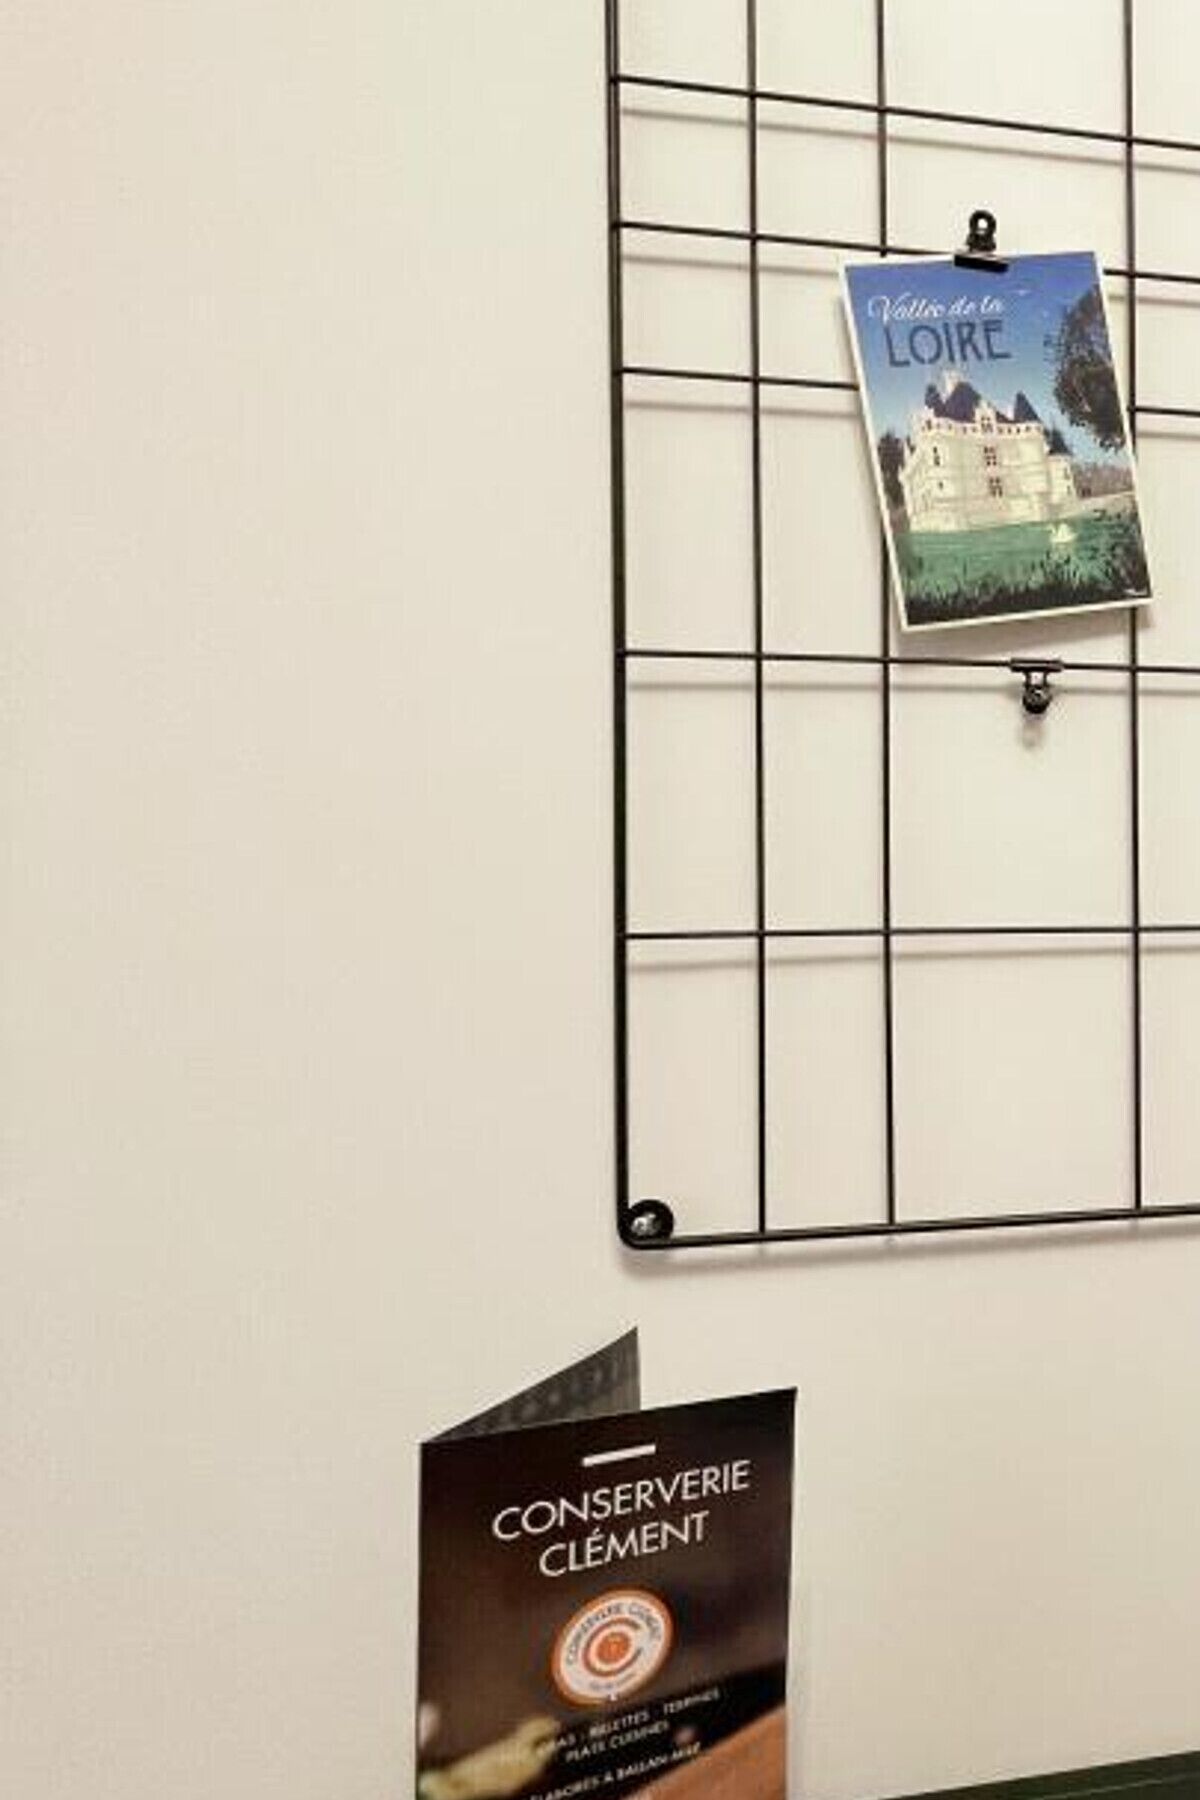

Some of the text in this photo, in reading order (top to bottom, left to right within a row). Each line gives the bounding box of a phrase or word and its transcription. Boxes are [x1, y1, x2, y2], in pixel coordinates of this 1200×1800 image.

[980, 295, 1003, 314] la
[884, 319, 1012, 367] LOIRE
[492, 1459, 751, 1541] CONSERVERIE
[538, 1510, 710, 1577] CLÉMENT
